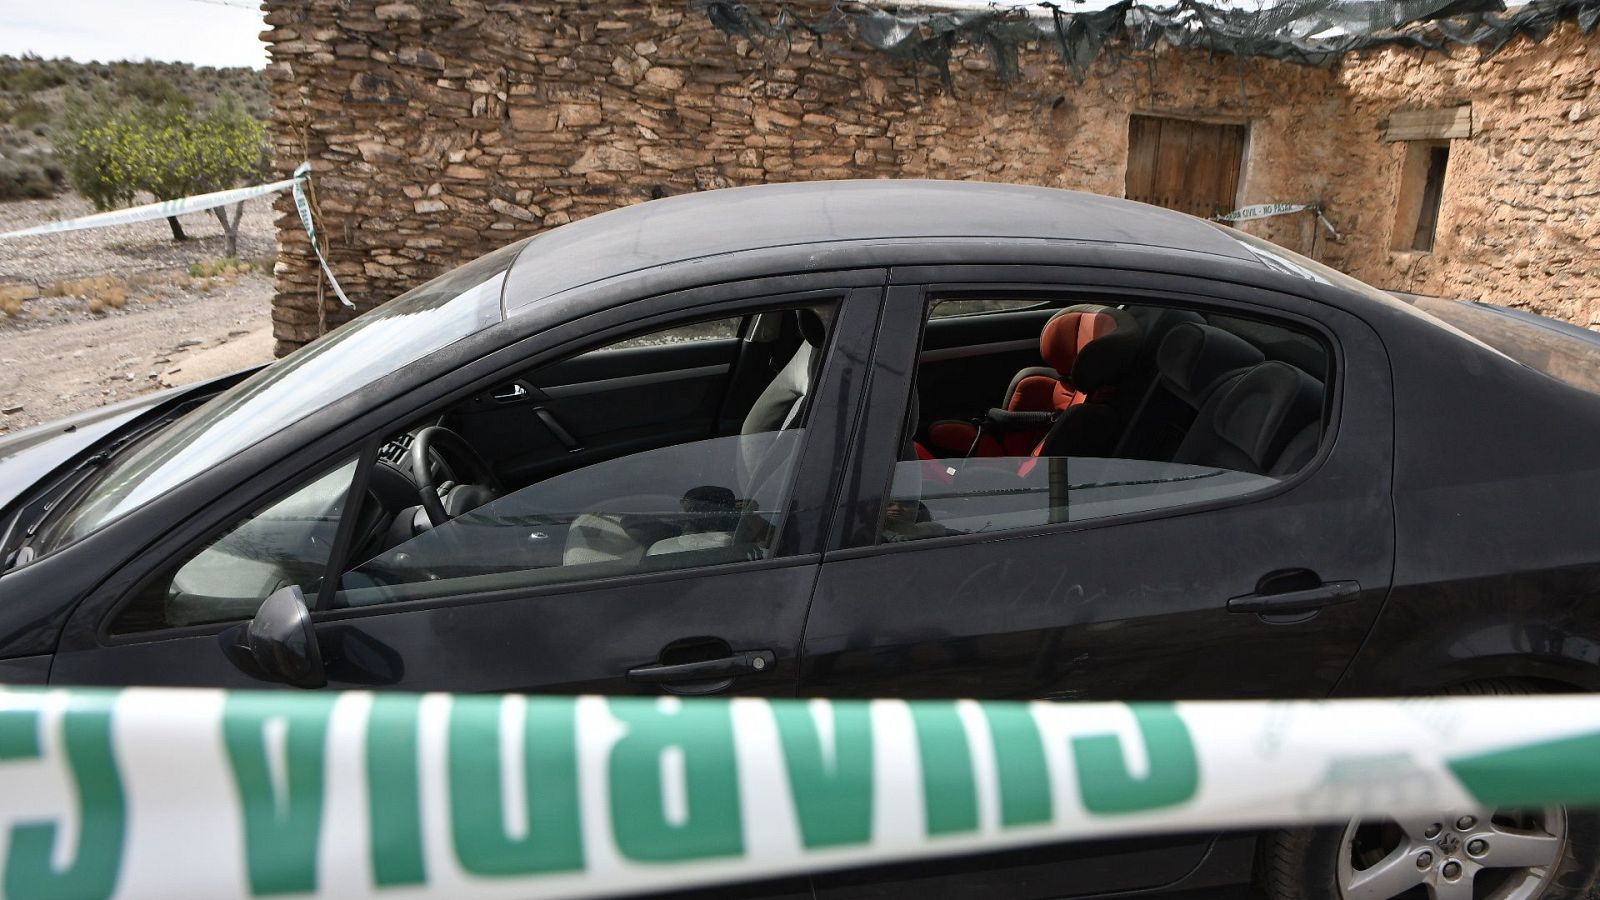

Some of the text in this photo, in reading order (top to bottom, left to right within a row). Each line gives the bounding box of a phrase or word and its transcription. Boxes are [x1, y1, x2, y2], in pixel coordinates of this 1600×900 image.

[1242, 208, 1257, 217] CIVIL
[1263, 205, 1272, 215] NO
[221, 690, 1201, 896] GUARDIA
